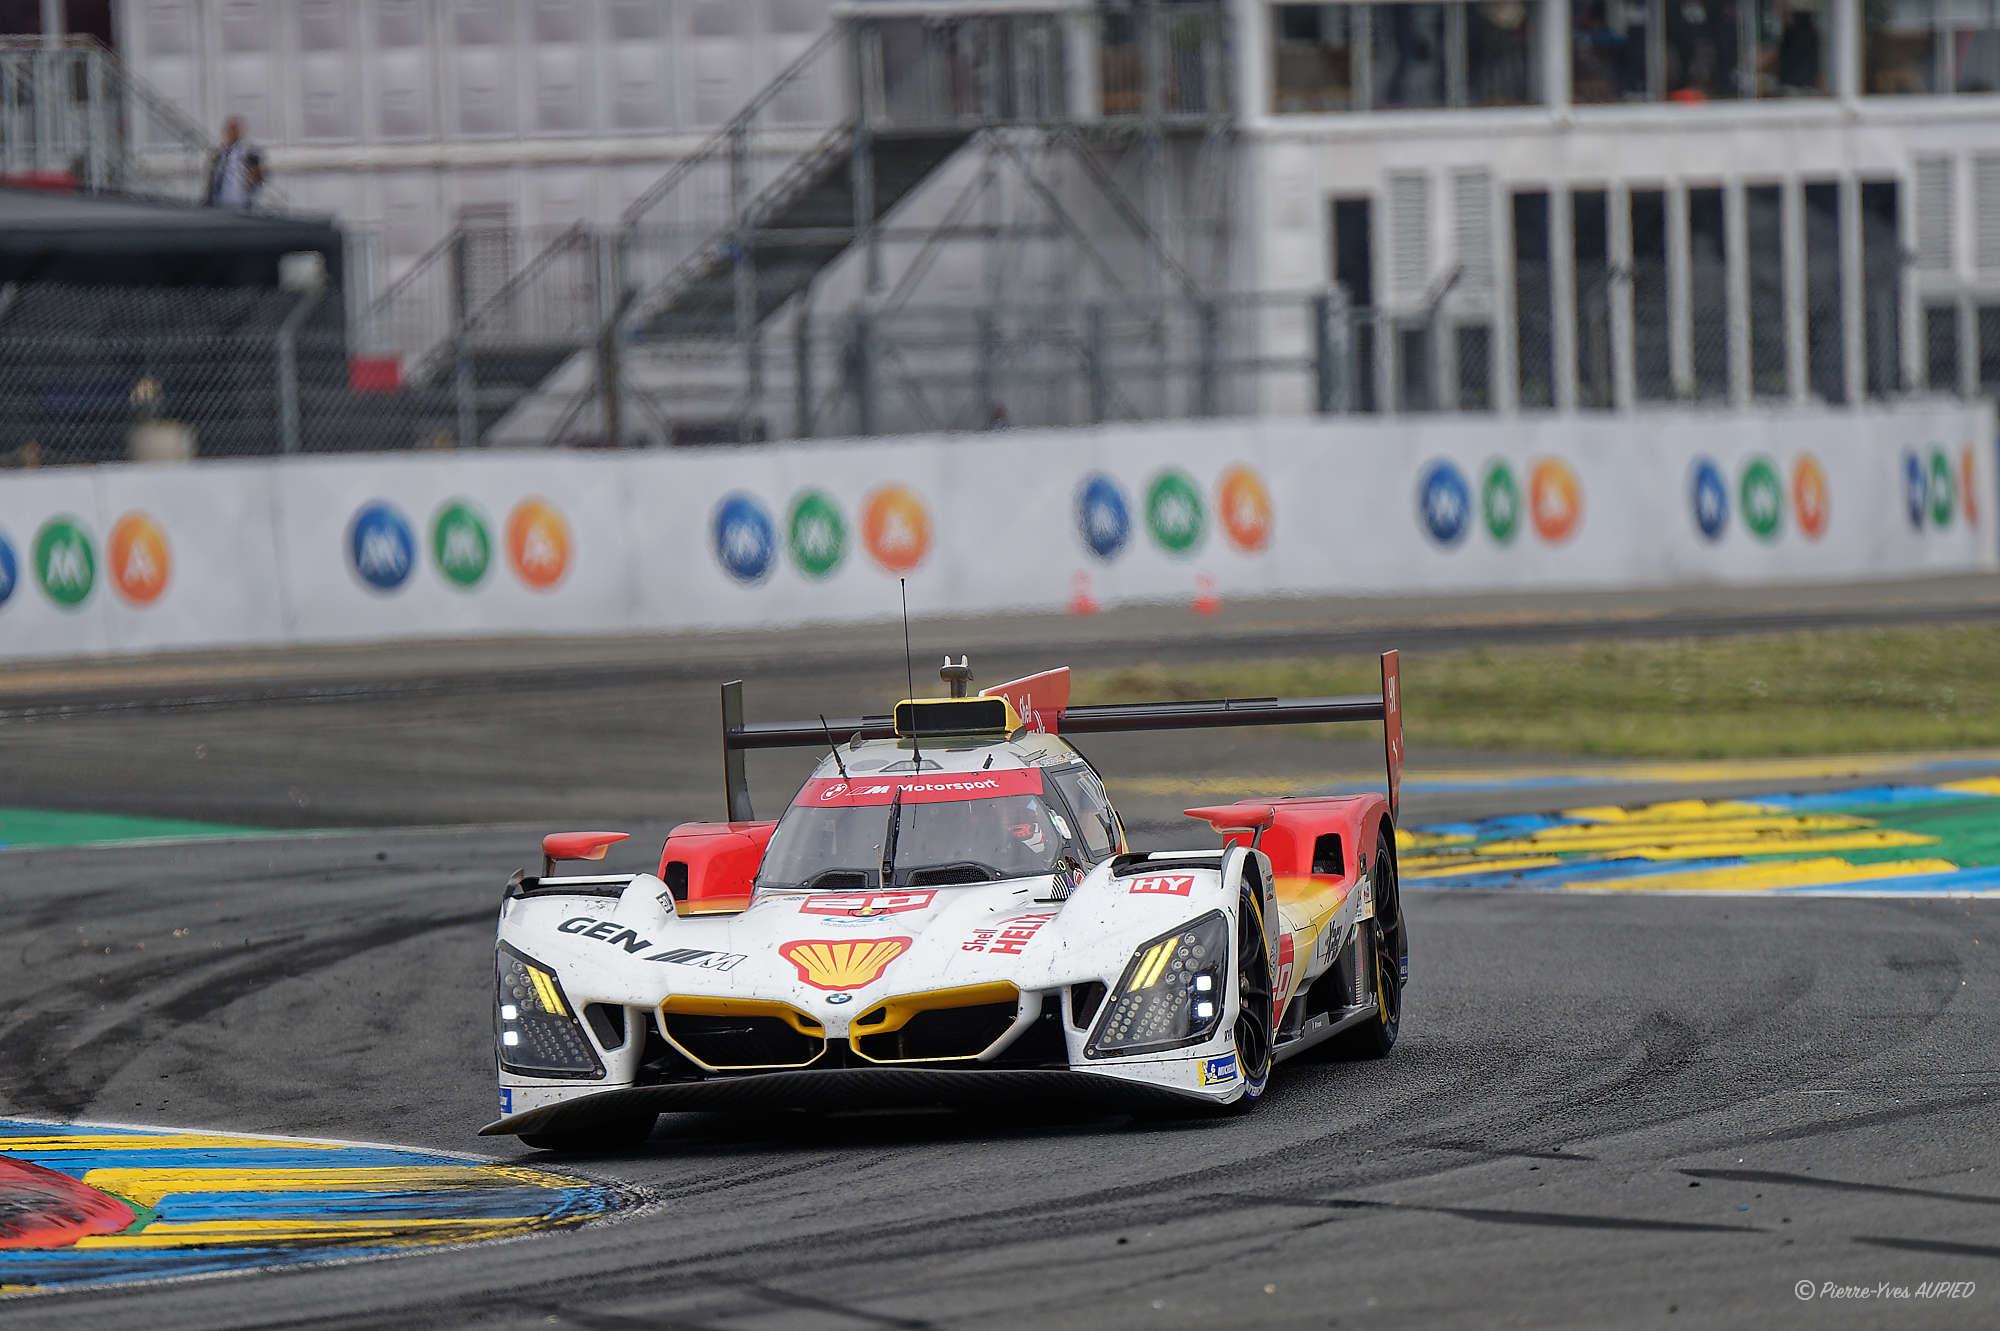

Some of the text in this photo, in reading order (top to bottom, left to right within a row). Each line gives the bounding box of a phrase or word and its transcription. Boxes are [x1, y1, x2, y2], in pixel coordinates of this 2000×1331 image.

[897, 779, 999, 792] Motorsport
[1133, 877, 1193, 893] HY
[806, 894, 930, 910] 20
[557, 917, 654, 954] GEN
[962, 929, 998, 952] Shell
[988, 912, 1058, 956] HELIX
